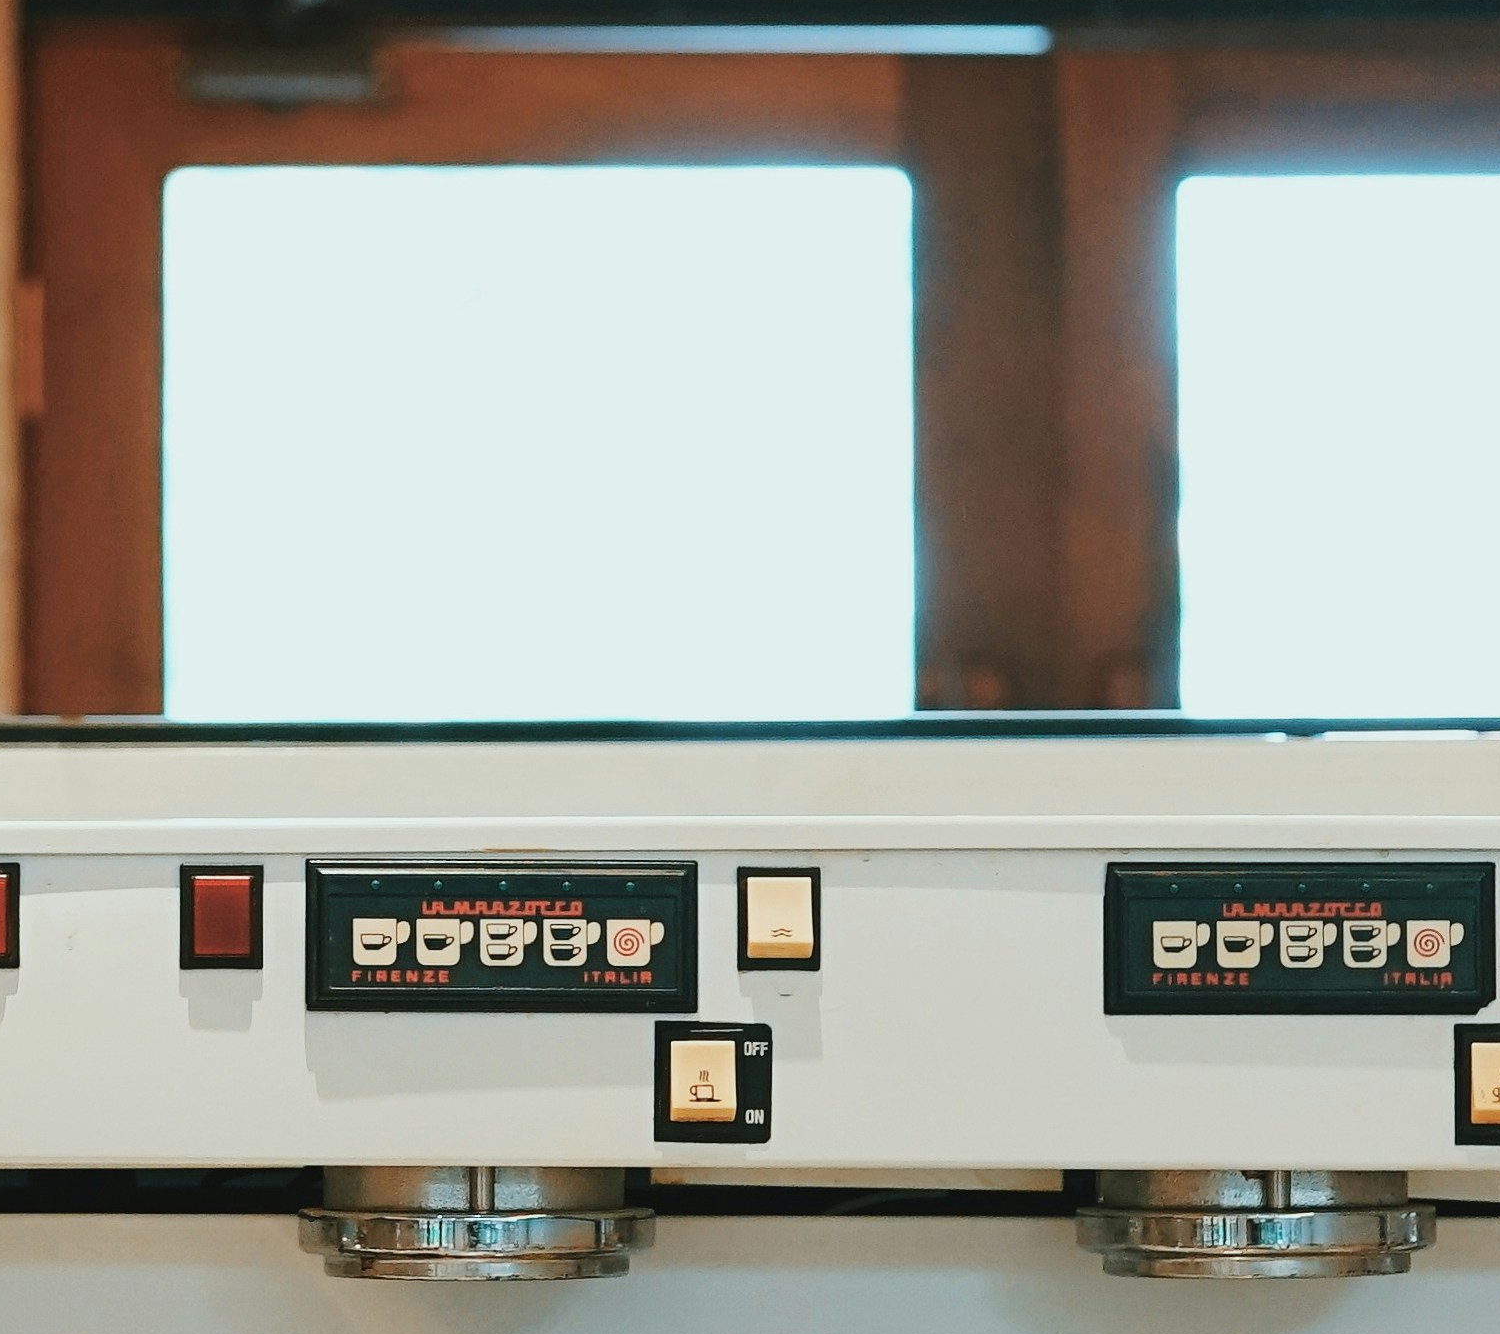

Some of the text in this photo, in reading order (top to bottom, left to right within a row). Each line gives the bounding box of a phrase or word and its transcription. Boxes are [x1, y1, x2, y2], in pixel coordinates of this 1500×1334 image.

[351, 969, 653, 984] FIRENZE ITALIA
[1152, 971, 1453, 986] FIRENZE ITALIA
[743, 1041, 769, 1057] OFF
[744, 1109, 765, 1125] ON
